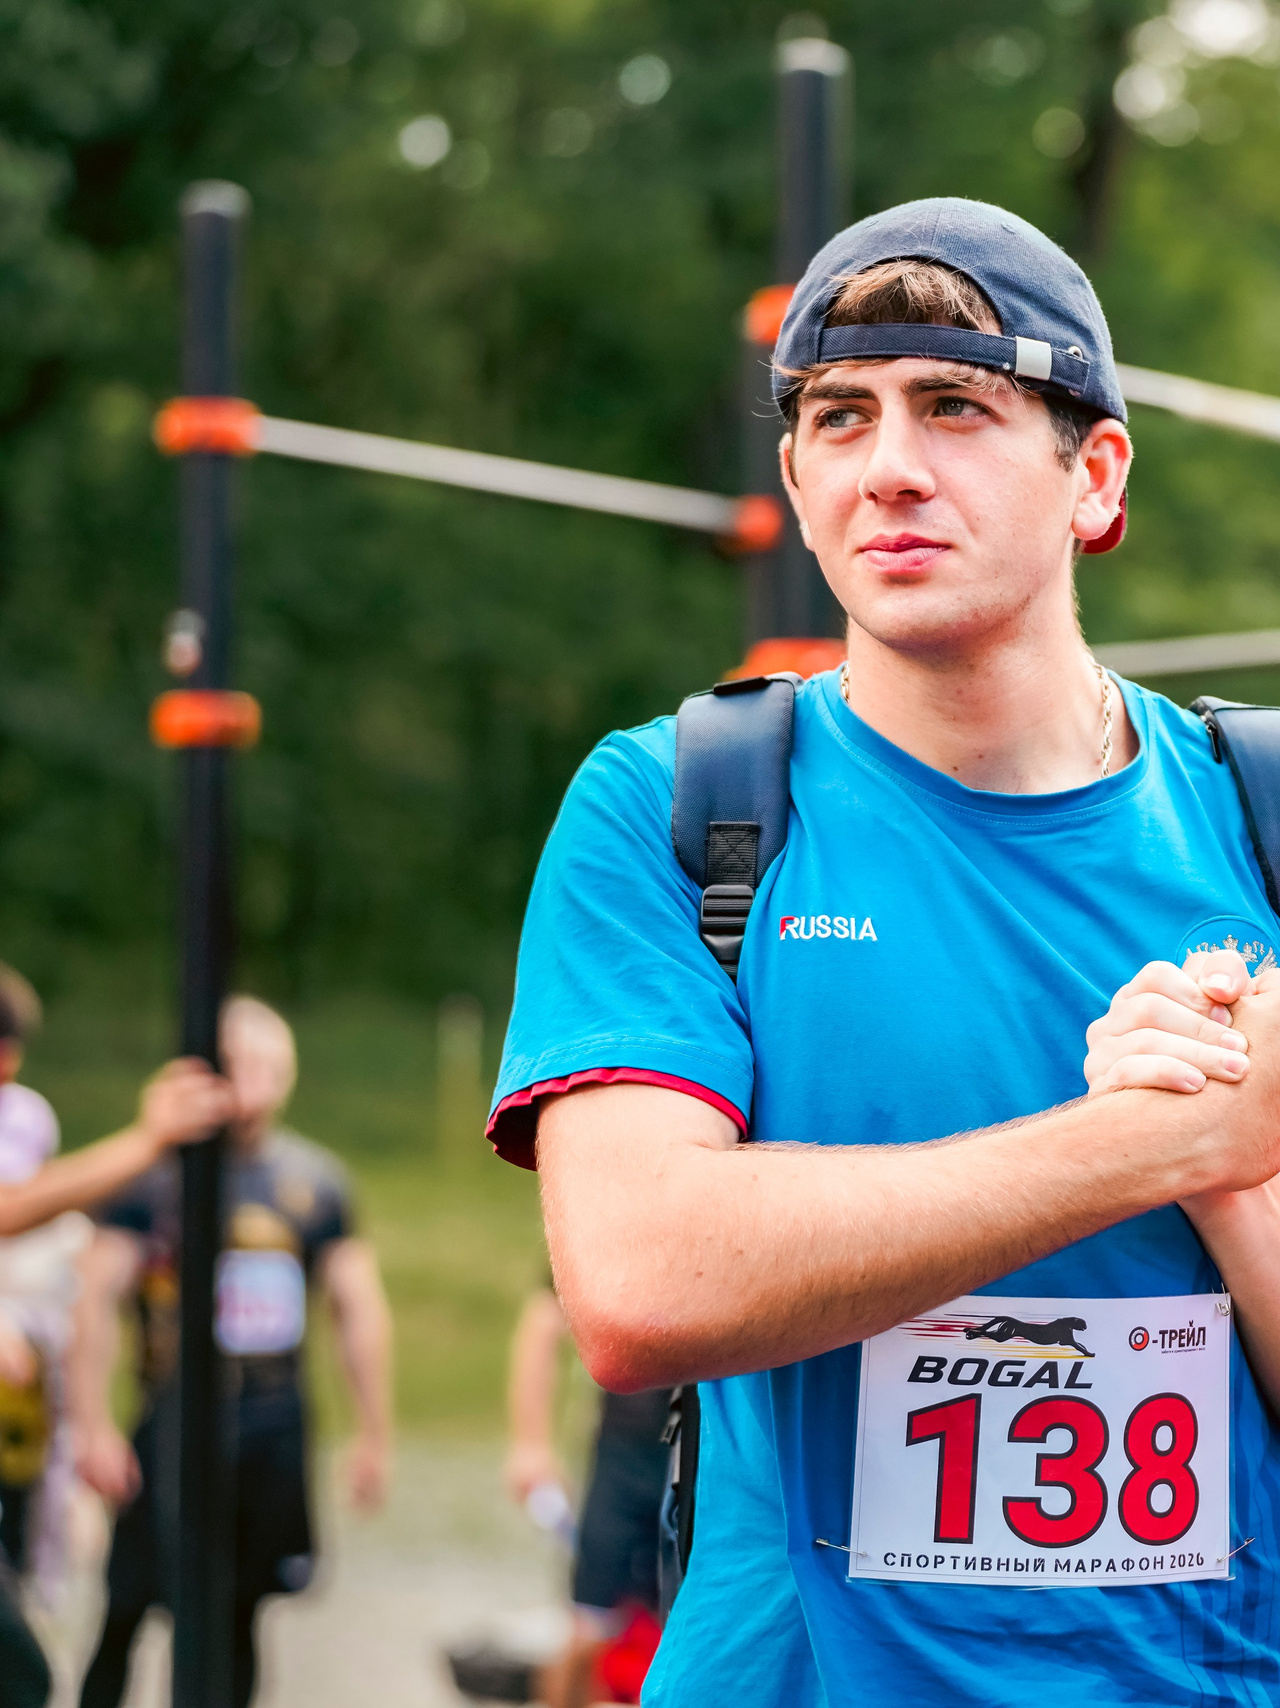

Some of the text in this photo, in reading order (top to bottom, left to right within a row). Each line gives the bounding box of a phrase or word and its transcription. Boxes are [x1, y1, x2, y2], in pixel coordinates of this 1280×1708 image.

[780, 914, 878, 942] RUSSIA
[907, 1355, 1095, 1389] BOGAL
[905, 1392, 1200, 1549] 138
[883, 1551, 1205, 1573] СПОРТИВНЫЙ МАРАФОН 2026
